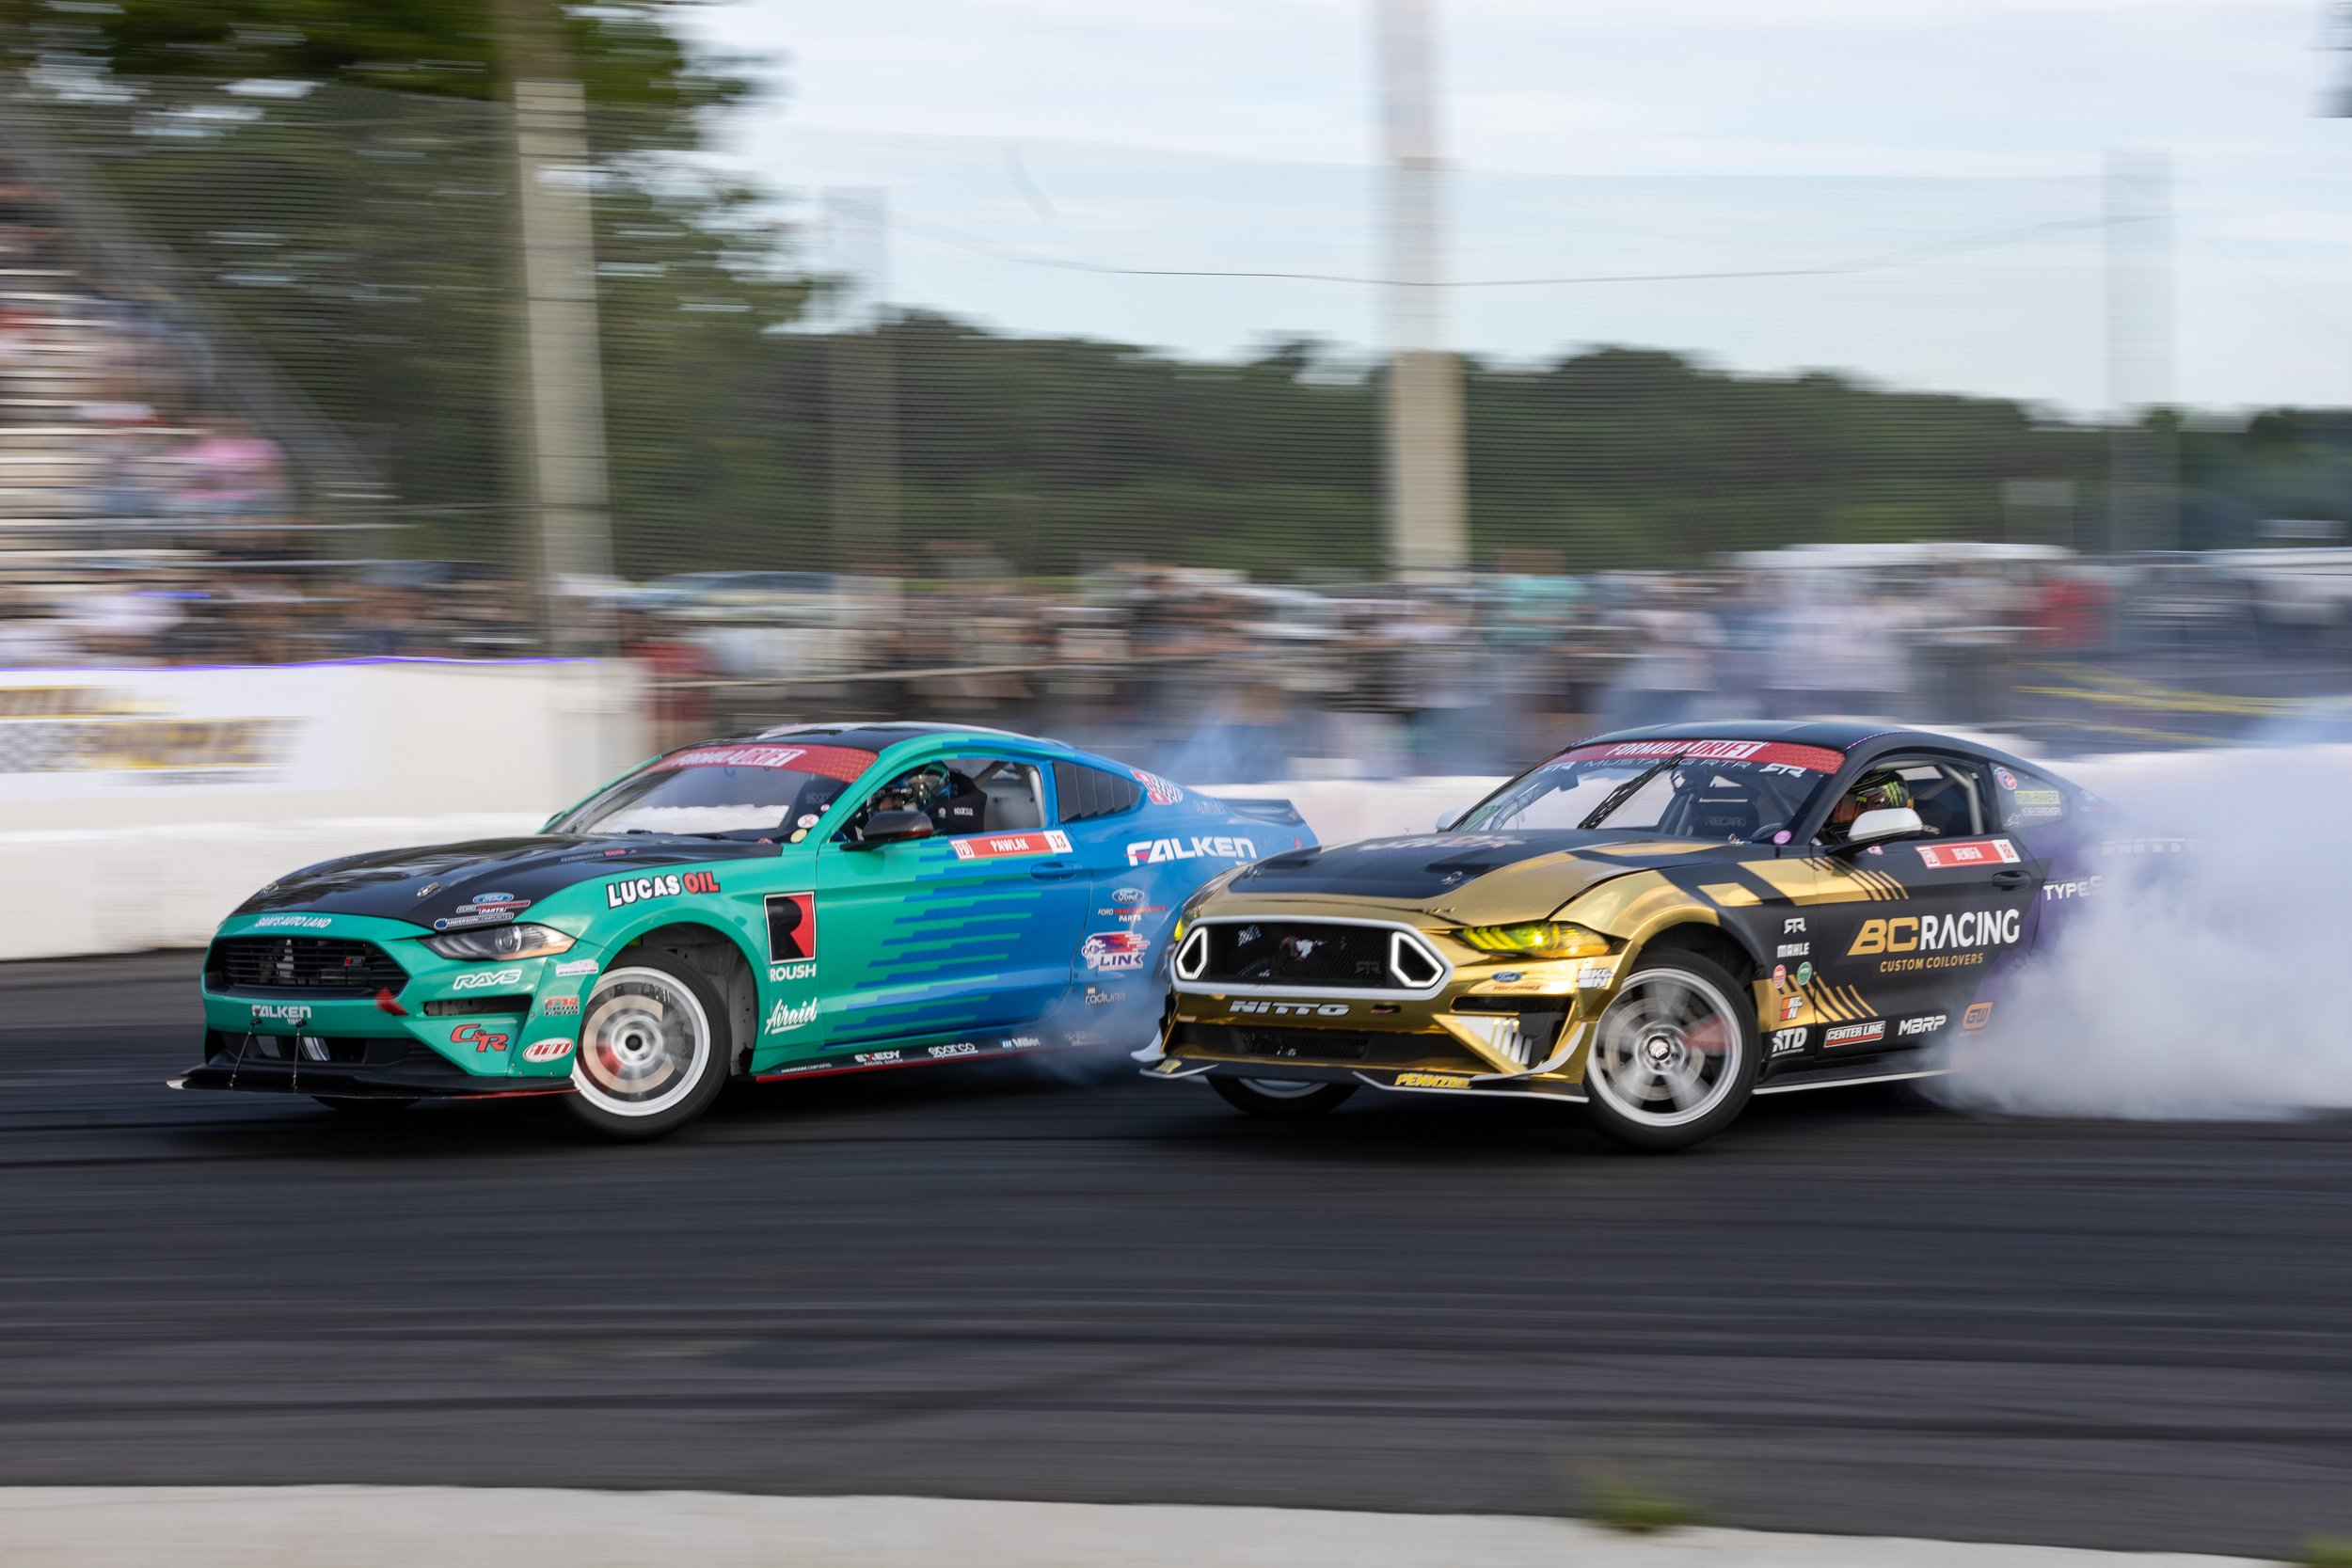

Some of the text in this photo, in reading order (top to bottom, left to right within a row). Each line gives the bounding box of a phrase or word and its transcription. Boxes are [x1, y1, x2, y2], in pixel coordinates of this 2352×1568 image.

[990, 837, 1029, 852] PAWLAK
[1050, 834, 1066, 849] 13
[1126, 836, 1258, 866] FALKEN
[607, 871, 721, 910] LUCAS OIL
[2042, 881, 2090, 901] TYPE
[1098, 908, 1114, 916] FORD
[1118, 914, 1142, 923] PARTS
[280, 916, 306, 927] AUTO
[302, 917, 332, 928] LAND
[1847, 909, 2020, 956] BC RACING
[1776, 942, 1810, 958] MAHLE
[1099, 952, 1145, 967] LINK
[1880, 952, 1983, 973] CUSTOM COILOVERS
[453, 969, 522, 990] RAYS
[770, 964, 817, 982] ROUSH
[1085, 989, 1126, 1006] radium
[251, 1005, 312, 1019] FALKEN
[765, 997, 818, 1035] Airaid
[1229, 1000, 1350, 1016] NITTO
[1827, 1022, 1884, 1040] CENTER LINE
[1898, 1015, 1947, 1036] MBRP
[928, 1042, 976, 1058] sparco
[1394, 1073, 1473, 1089] PENNZOIL
